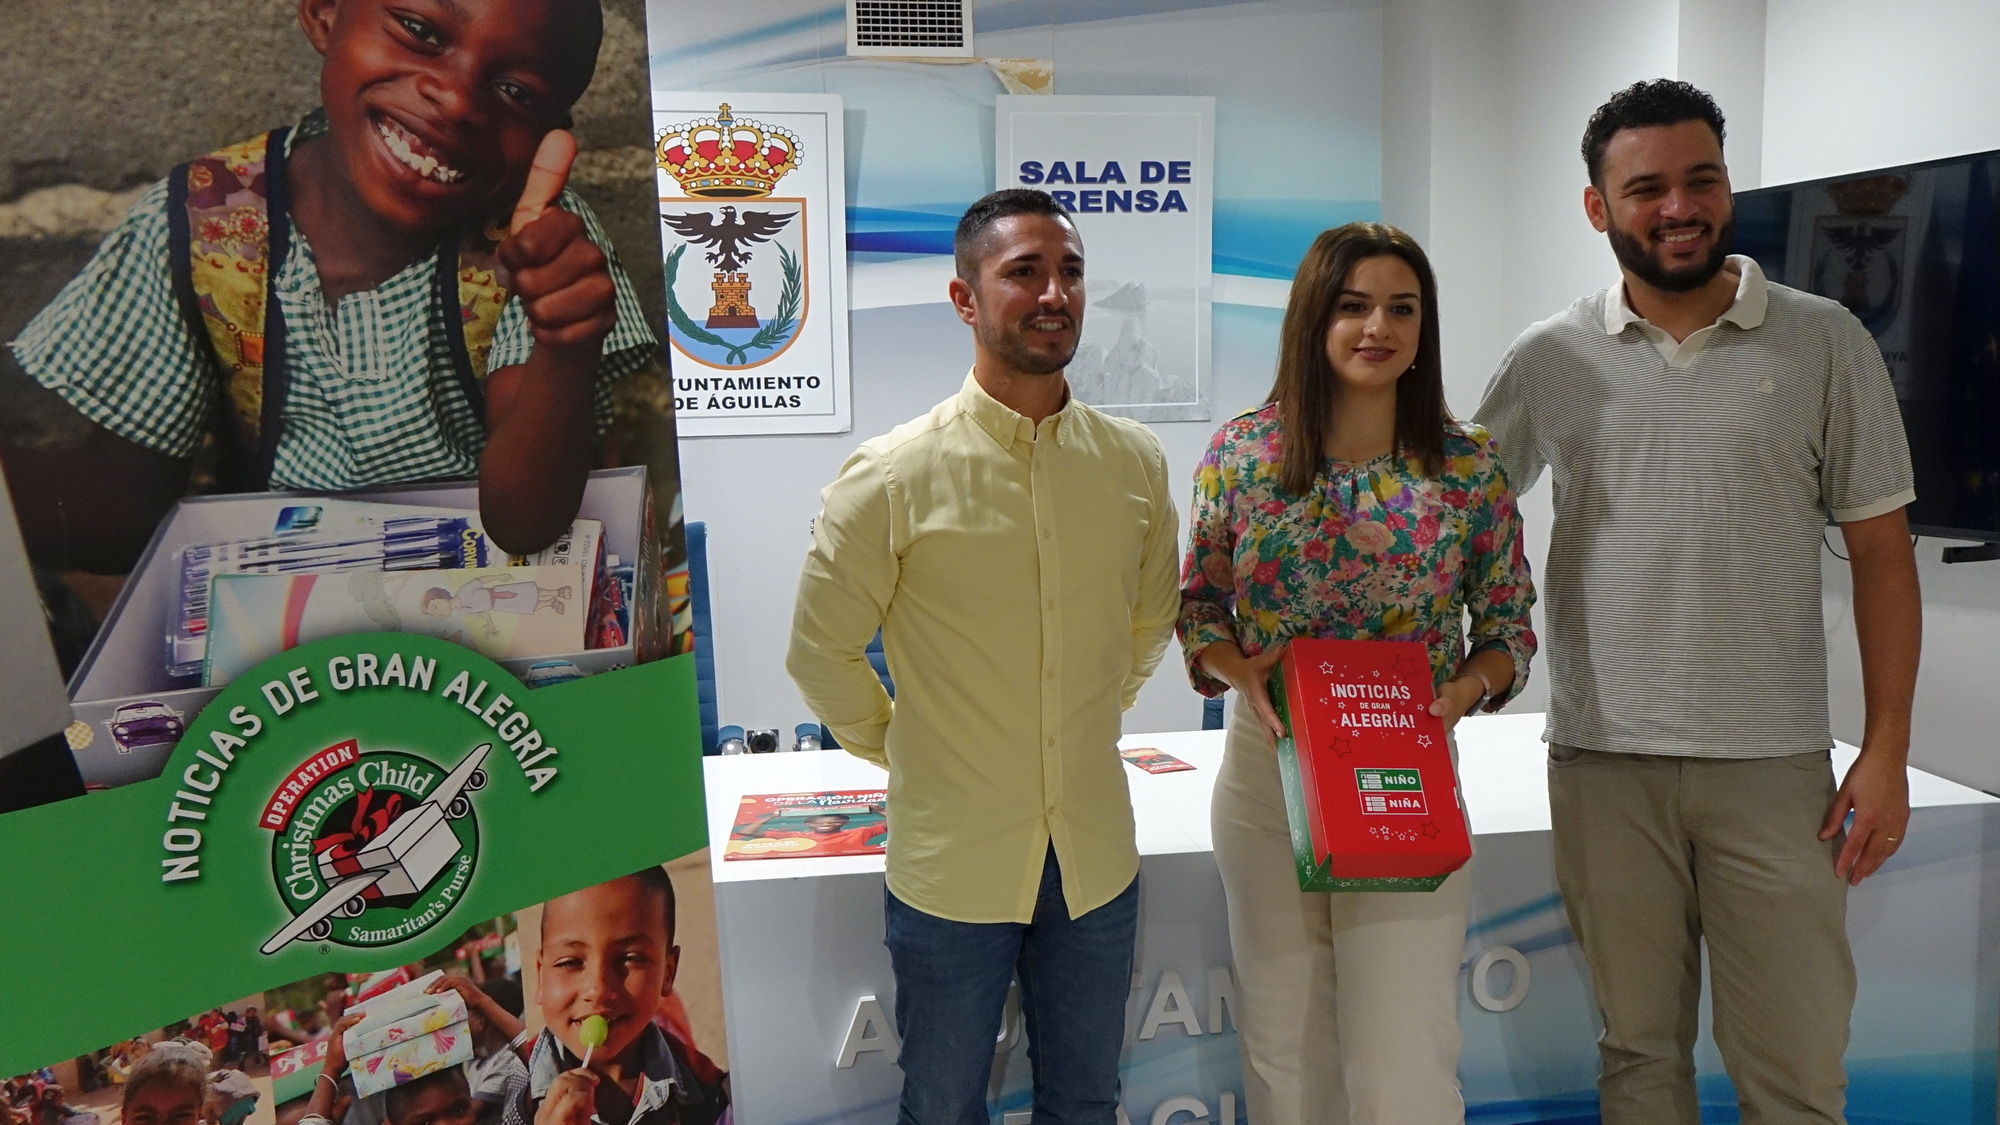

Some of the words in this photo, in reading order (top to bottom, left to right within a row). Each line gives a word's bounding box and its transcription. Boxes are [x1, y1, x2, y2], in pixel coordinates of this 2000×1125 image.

[1019, 160, 1127, 184] SALA
[1140, 160, 1192, 184] DE
[1050, 189, 1188, 213] RENSA
[706, 393, 801, 410] ÁGUILAS
[1330, 682, 1411, 699] ¡NOTICIAS
[1371, 702, 1391, 710] GRAN
[1341, 711, 1415, 728] ALEGRÍA!
[162, 705, 263, 882] NOTICIAS
[261, 666, 319, 716] DE
[328, 653, 437, 691] GRAN
[441, 670, 558, 792] ALEGRÍA
[267, 745, 353, 825] OPERATION
[1384, 774, 1416, 785] NIÑO
[1389, 797, 1421, 808] NIÑA
[285, 776, 354, 900] Christmas
[358, 760, 434, 796] Child
[440, 854, 472, 903] Purse
